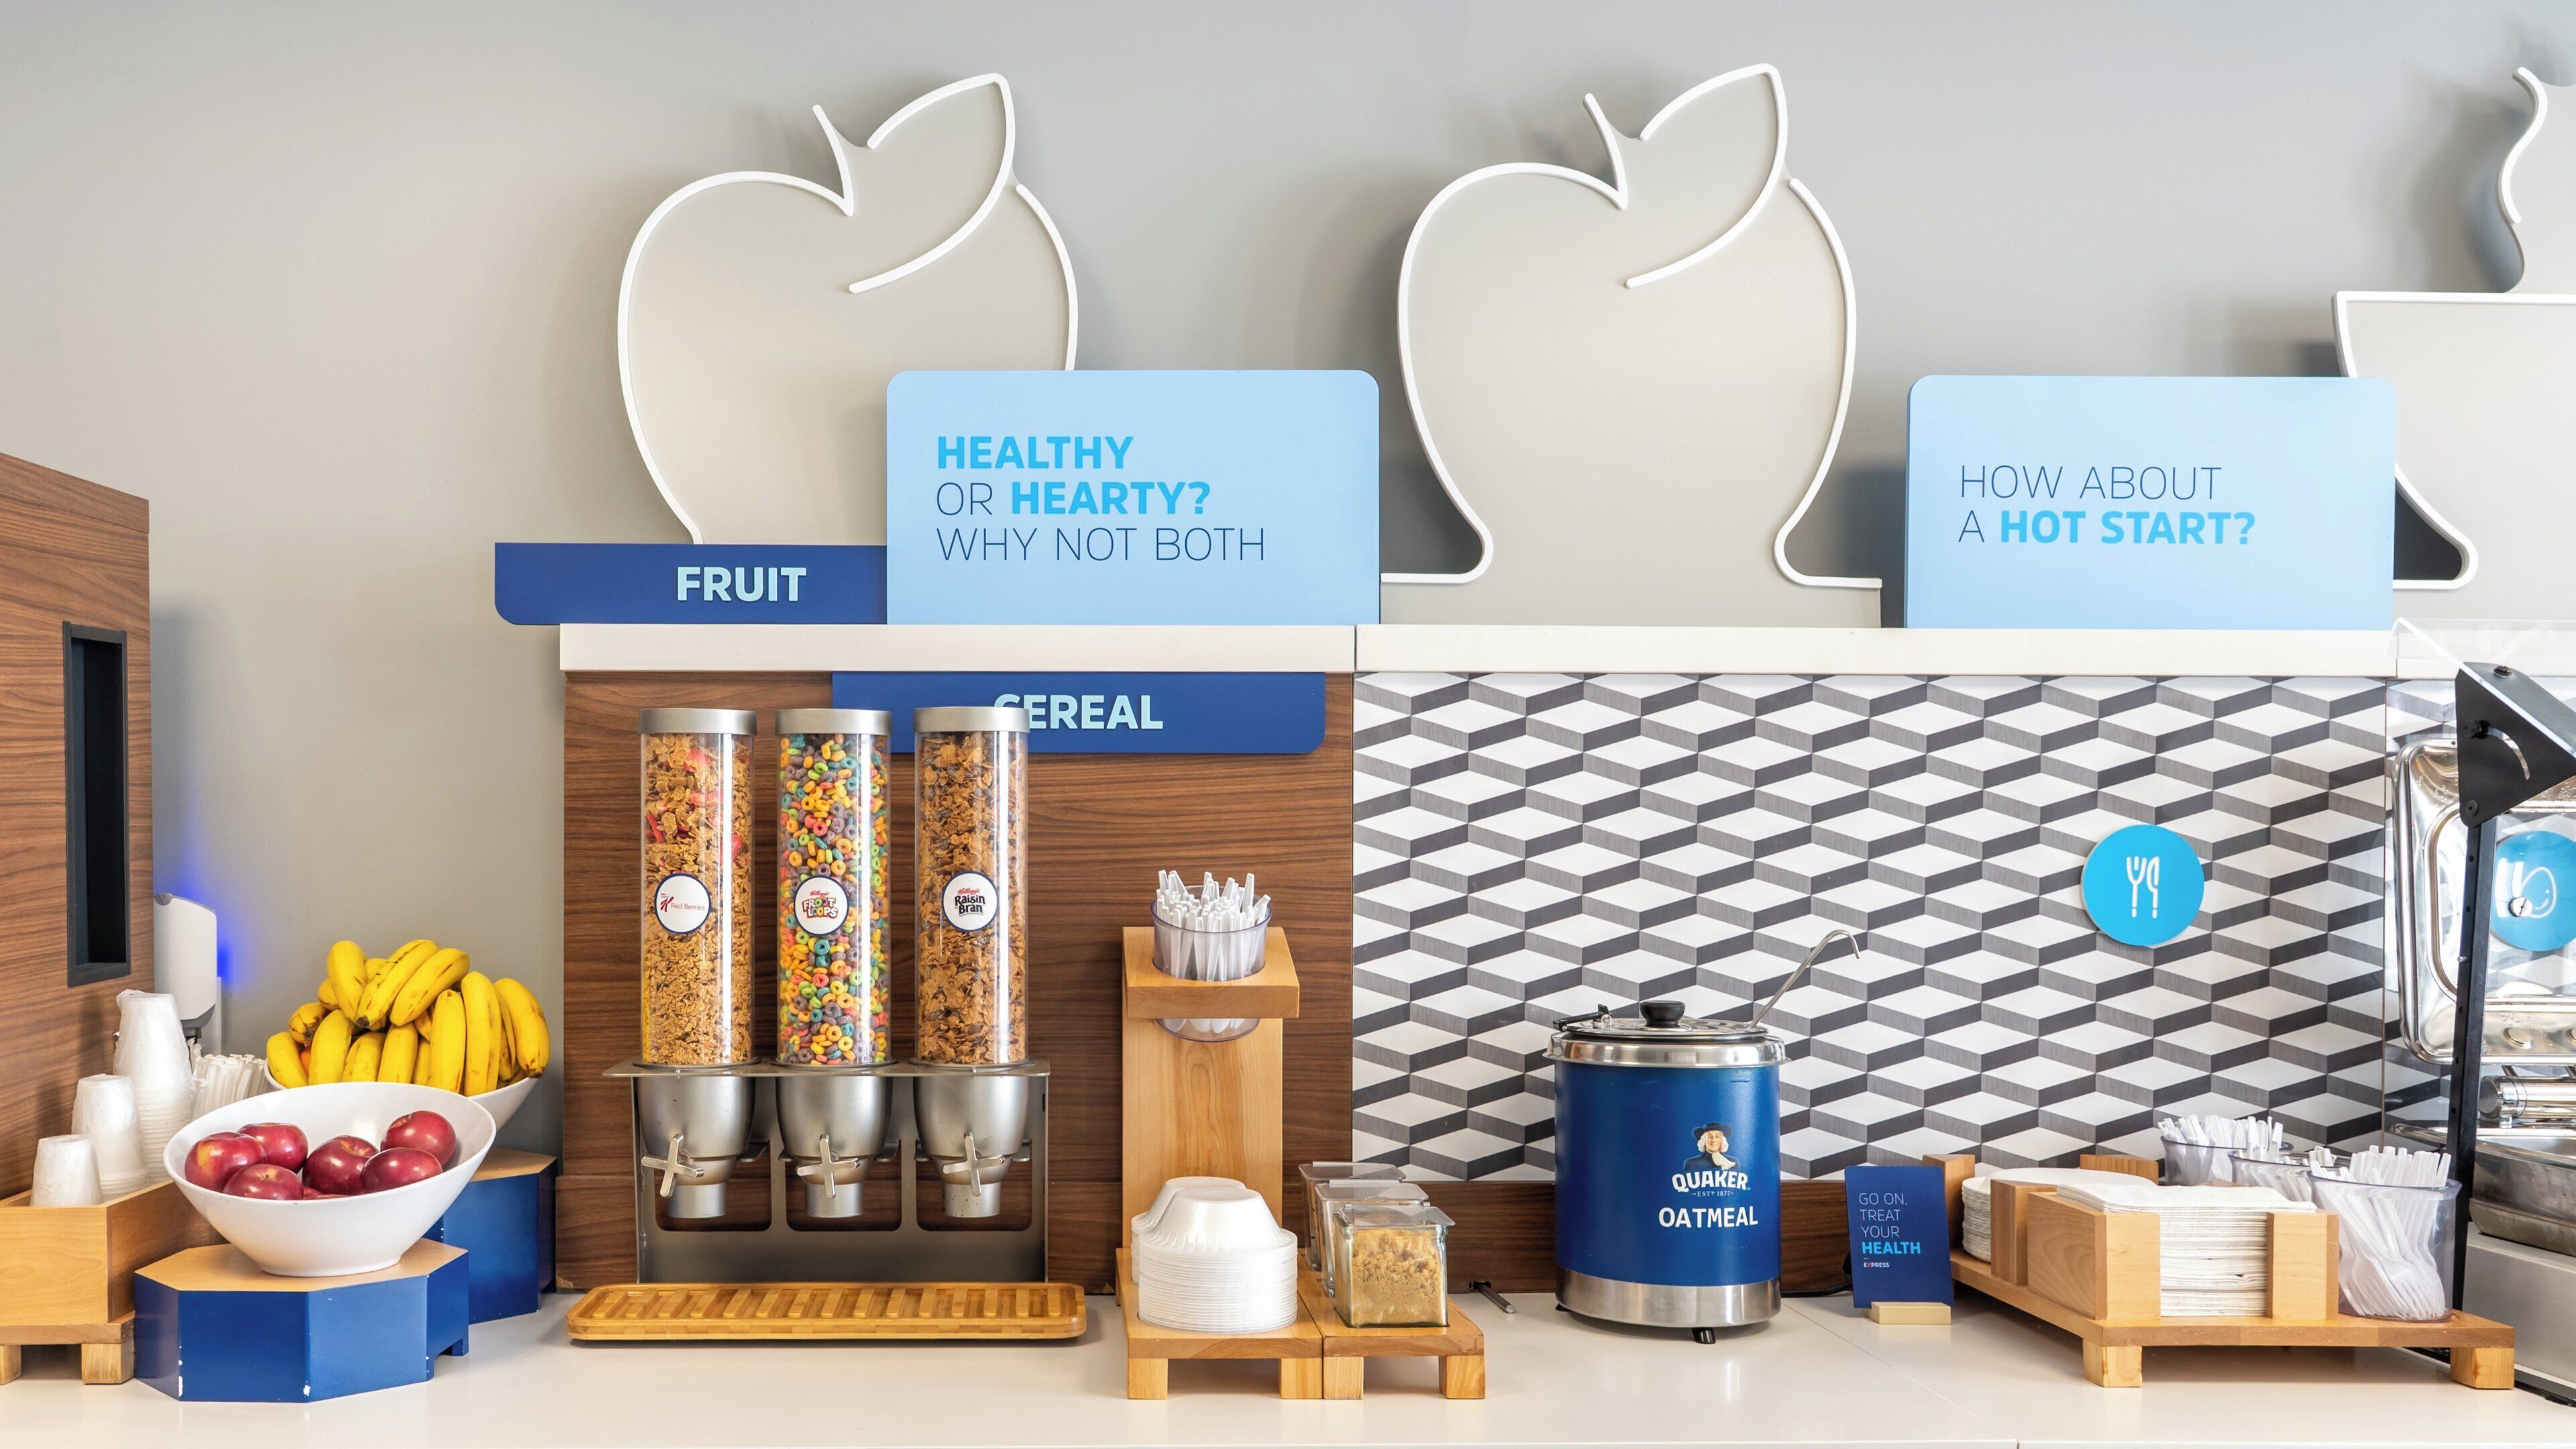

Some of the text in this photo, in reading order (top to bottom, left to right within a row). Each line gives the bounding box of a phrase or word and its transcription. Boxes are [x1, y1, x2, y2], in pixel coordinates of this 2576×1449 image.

[937, 435, 1133, 469] HEALTHY
[1961, 464, 2222, 500] HOW ABOUT
[936, 482, 1210, 515] OR HEARTY?
[1958, 510, 2255, 545] A HOT START?
[936, 527, 1265, 561] WHY NOT BOTH
[677, 566, 807, 602] FRUIT
[955, 895, 985, 906] Raisin
[959, 904, 983, 914] Bran
[1672, 1171, 1748, 1192] QUAKER
[1859, 1193, 1907, 1205] GO ON,
[1659, 1206, 1758, 1228] OATMEAL
[1860, 1210, 1900, 1221] TREAT
[1861, 1226, 1899, 1238] YOUR
[1862, 1242, 1921, 1254] HEALTH
